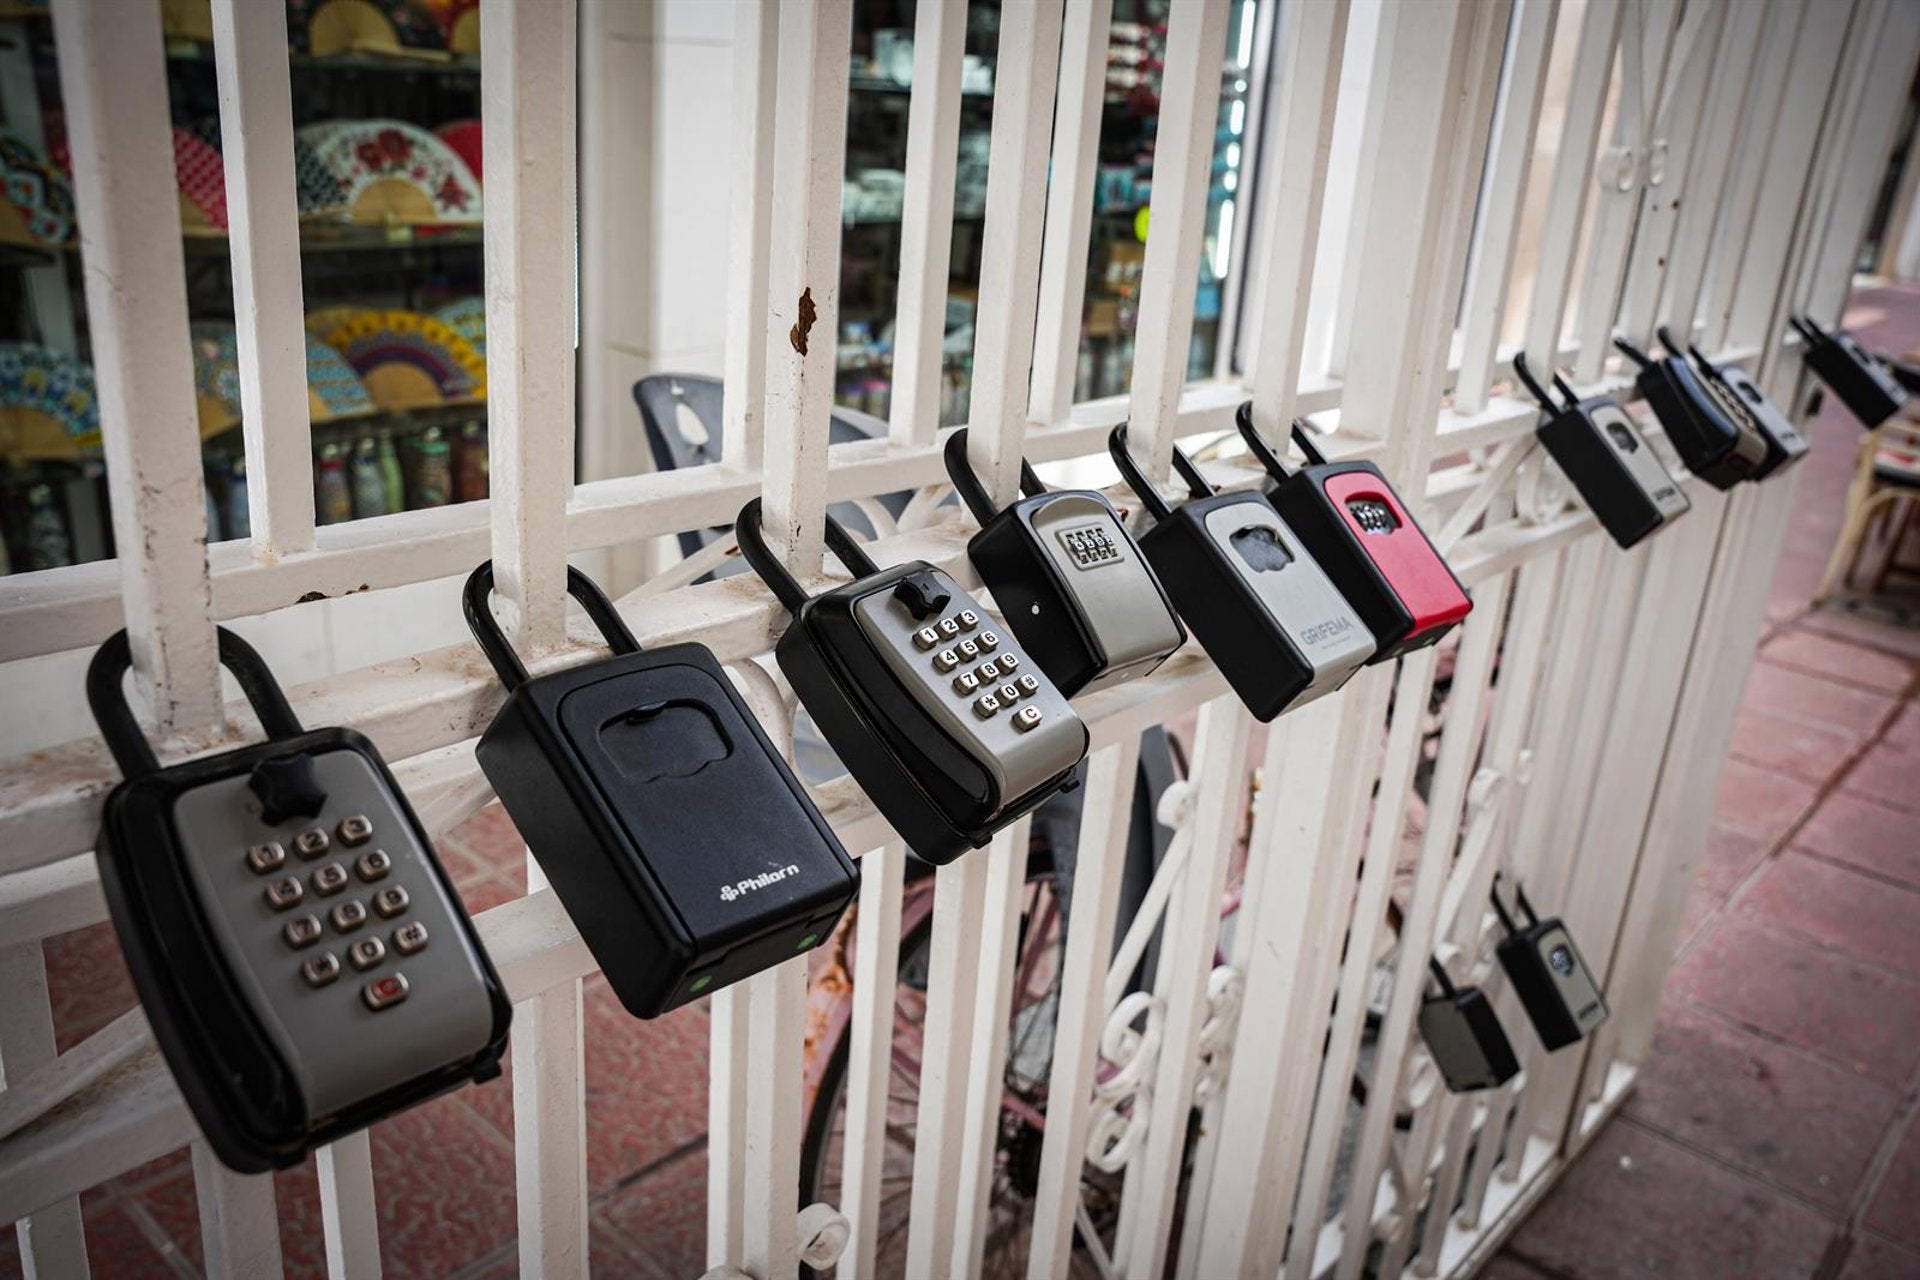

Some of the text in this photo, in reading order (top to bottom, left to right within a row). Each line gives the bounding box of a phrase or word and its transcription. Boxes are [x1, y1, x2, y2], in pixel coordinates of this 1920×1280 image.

[944, 620, 957, 630] 2
[965, 612, 976, 622] 3
[1301, 616, 1352, 645] GRIFEMA
[984, 665, 996, 675] 8
[1025, 708, 1037, 719] C
